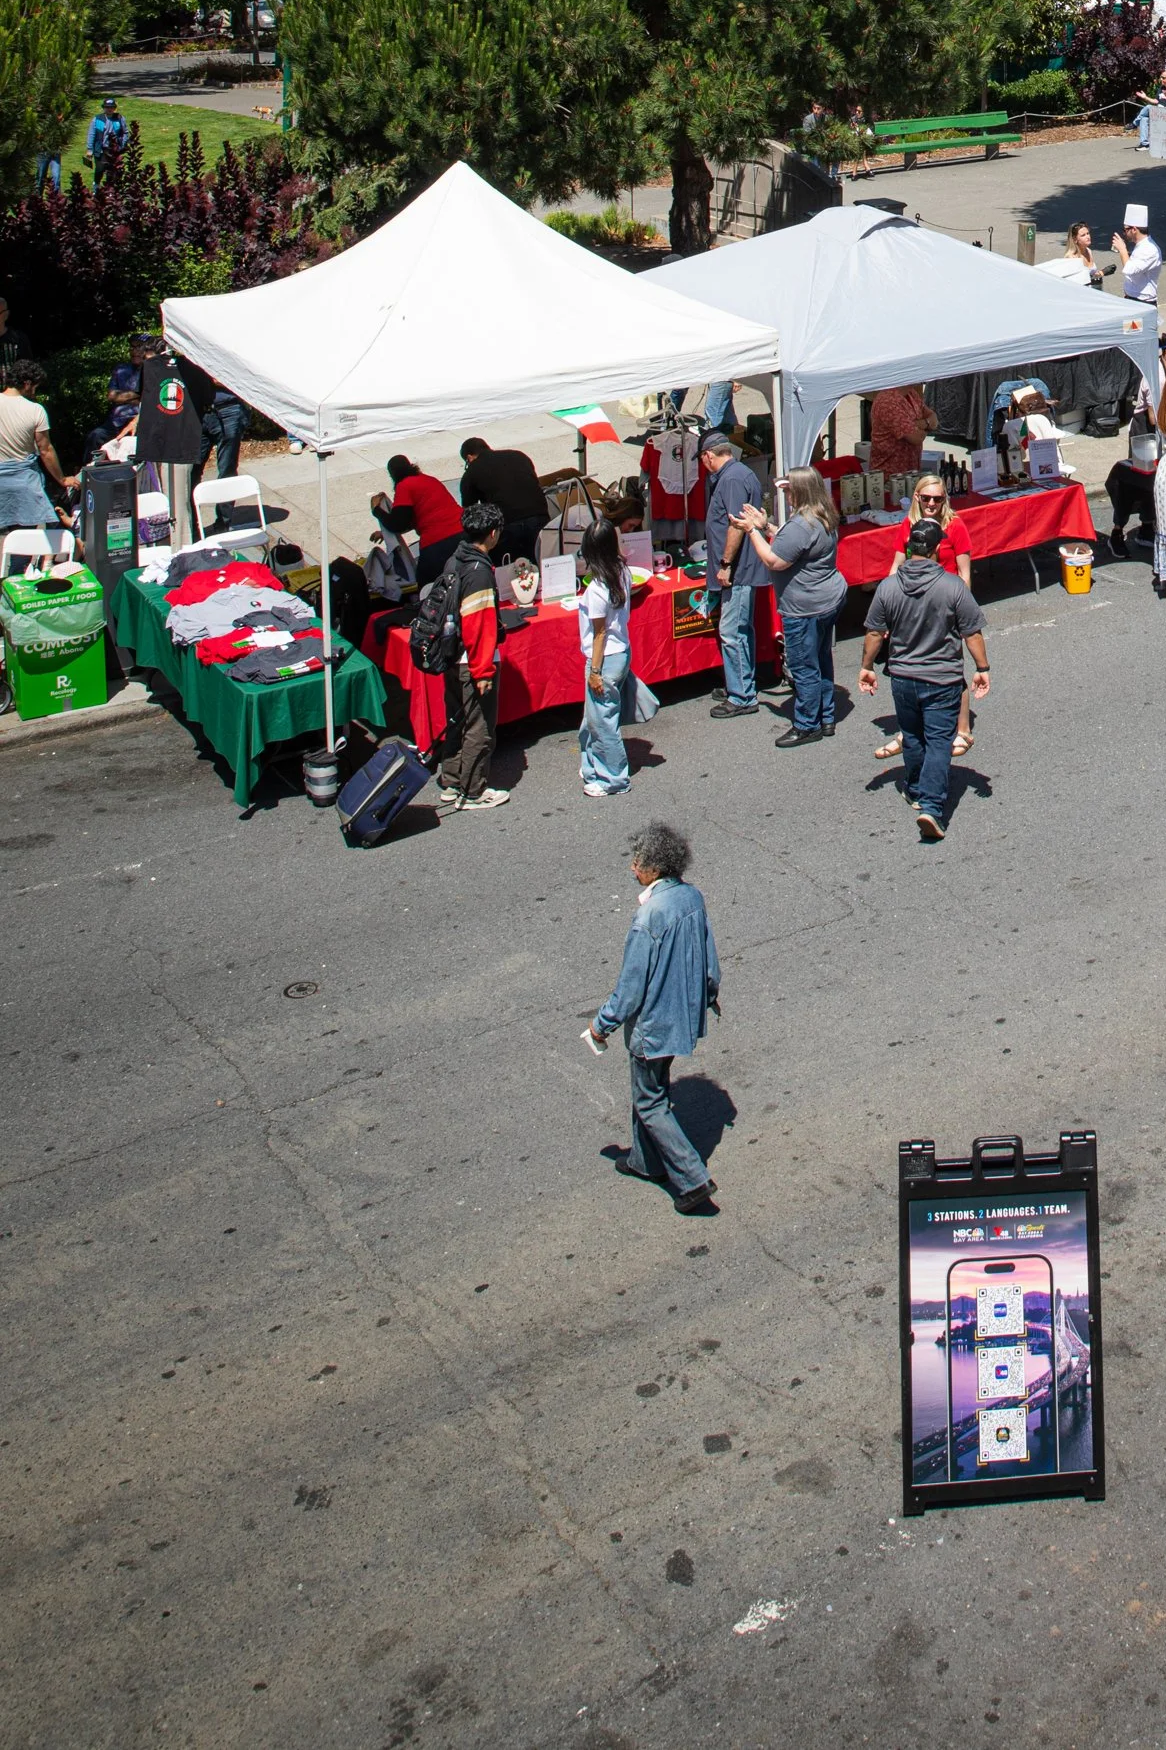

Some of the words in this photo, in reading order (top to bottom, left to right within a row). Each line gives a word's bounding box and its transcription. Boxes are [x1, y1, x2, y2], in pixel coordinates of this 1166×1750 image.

[22, 600, 46, 610] SOILED
[48, 596, 70, 606] PAPER
[76, 592, 96, 600] FOOD
[24, 631, 100, 654] COMPOST
[59, 646, 84, 656] Abono
[50, 687, 77, 696] Recology
[927, 1212, 932, 1222] 3
[934, 1210, 978, 1222] STATIONS.
[979, 1210, 984, 1219] 2
[986, 1206, 1038, 1219] LANGUAGES.
[1044, 1204, 1070, 1214] TEAM.
[953, 1228, 972, 1238] NBC
